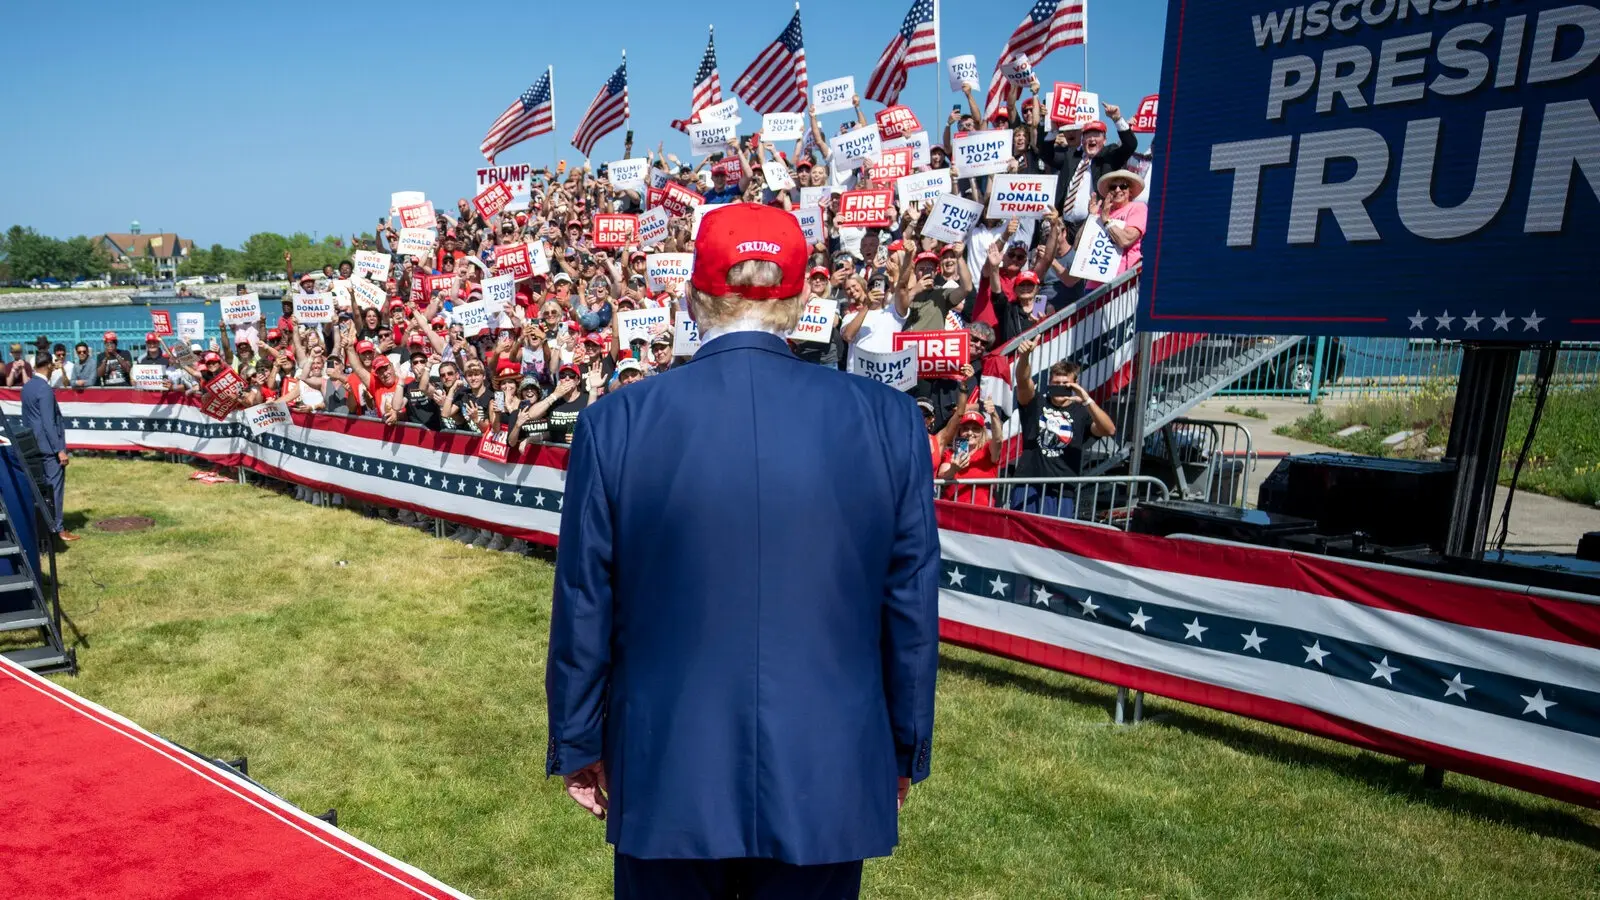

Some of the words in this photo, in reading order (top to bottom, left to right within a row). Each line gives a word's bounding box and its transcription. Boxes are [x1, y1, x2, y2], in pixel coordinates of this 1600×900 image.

[1251, 0, 1490, 47] WISCON
[952, 62, 976, 72] TRU
[1013, 63, 1027, 72] VO
[1008, 70, 1033, 79] DON
[817, 84, 849, 96] TRUMP
[1060, 88, 1078, 103] FI
[821, 93, 845, 103] 2024
[710, 105, 734, 117] RUMP
[1140, 100, 1158, 114] FI
[881, 109, 913, 126] FIRE
[696, 126, 730, 138] TRUMP
[701, 136, 726, 144] 2024
[838, 133, 875, 152] TRUMP
[846, 144, 873, 159] 2024
[959, 141, 1004, 155] TRUMP
[878, 152, 906, 167] IRE
[966, 152, 999, 164] 2024
[612, 164, 642, 174] TRUMP
[726, 160, 740, 171] RE
[477, 164, 529, 184] TRUMP
[617, 173, 638, 181] 2024
[727, 172, 741, 180] DEN
[927, 177, 943, 185] BIG
[1010, 183, 1042, 192] VOTE
[478, 185, 505, 208] FIRE
[651, 192, 661, 202] FI
[924, 190, 940, 198] RIG
[997, 193, 1050, 202] DONALD
[484, 194, 509, 215] BIDEN
[664, 200, 686, 214] BIDE
[846, 194, 886, 209] FIRE
[942, 204, 978, 222] TRUMP
[1000, 203, 1044, 212] TRUMP
[801, 216, 815, 224] BIG
[844, 211, 884, 222] BIDEN
[599, 219, 634, 231] FIRE
[640, 219, 665, 234] ONALD
[643, 229, 665, 241] RUMP
[402, 238, 431, 246] DONALD
[736, 241, 781, 254] TRUMP
[1089, 231, 1107, 264] 2024
[496, 250, 525, 268] FIRE
[656, 259, 682, 267] VOTE
[358, 261, 385, 269] DONALD
[651, 268, 689, 277] DONALD
[653, 277, 685, 285] TRUMP
[352, 284, 379, 304] DONALD
[224, 305, 256, 314] DONALD
[228, 311, 255, 319] TRUMP
[459, 308, 485, 319] TRUM
[807, 305, 820, 314] TE
[153, 314, 167, 324] RE
[464, 315, 488, 325] 2024
[624, 316, 664, 327] TRUMP
[800, 316, 827, 324] NALD
[154, 324, 169, 332] DEN
[798, 323, 822, 333] UMP
[858, 357, 911, 373] TRUMP
[918, 360, 960, 372] DEN
[210, 373, 236, 393] FIRE
[865, 371, 904, 384] 2024
[257, 406, 278, 414] VOTE
[253, 412, 286, 423] DONALD
[257, 417, 286, 428] TRUMP
[522, 423, 548, 431] TRUM
[483, 441, 506, 456] BIDEN
